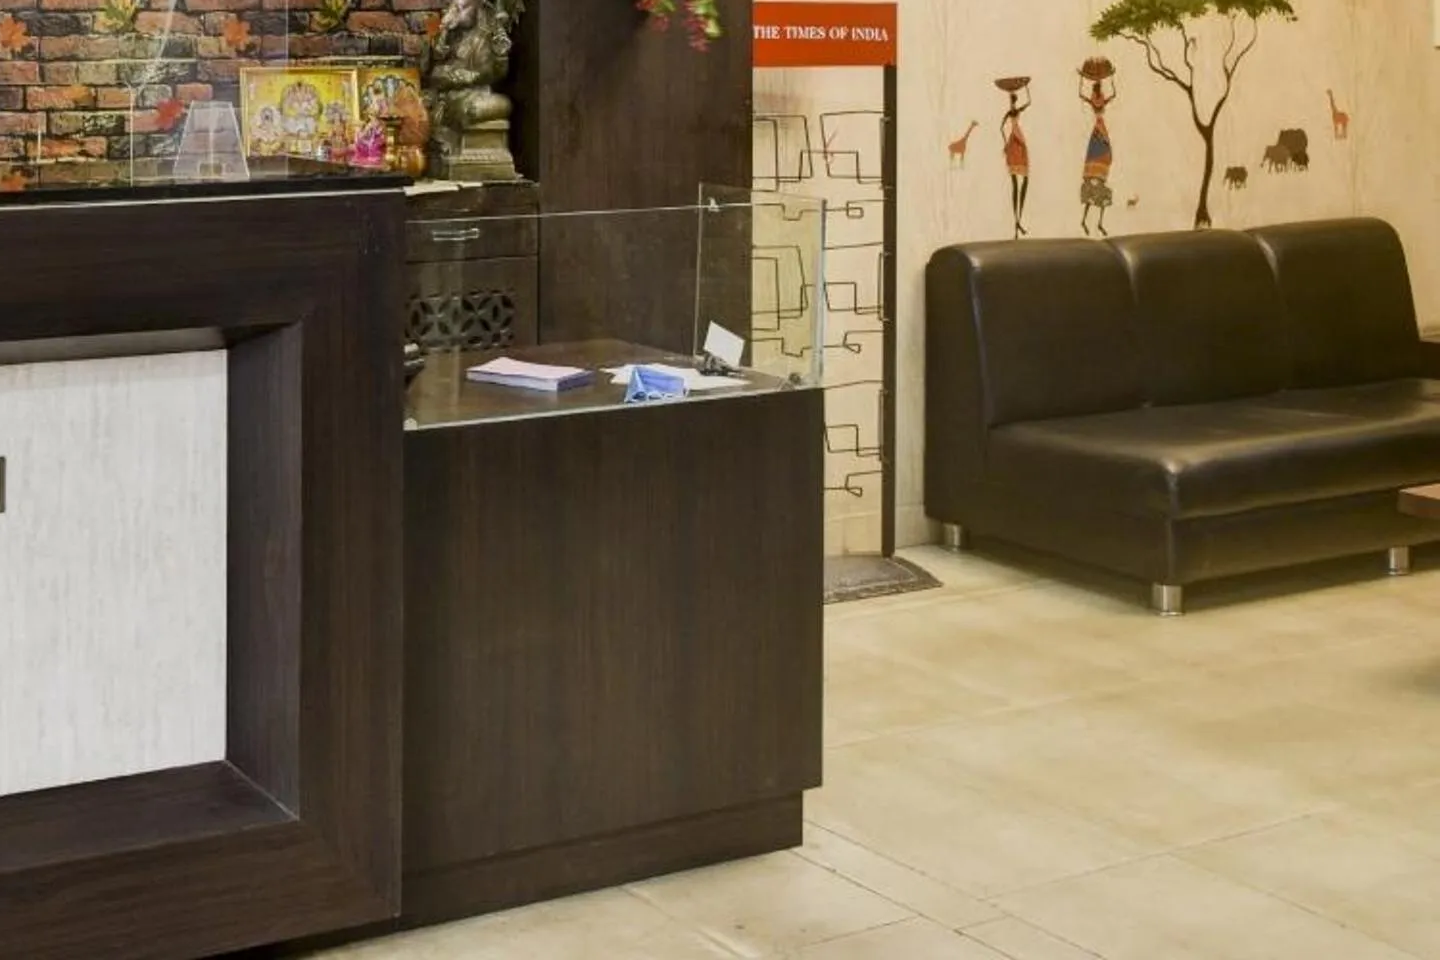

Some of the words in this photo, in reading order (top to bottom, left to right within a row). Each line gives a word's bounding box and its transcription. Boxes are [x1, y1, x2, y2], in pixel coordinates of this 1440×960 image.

[753, 24, 780, 40] THE
[784, 24, 826, 40] TIMES
[828, 26, 849, 40] OF
[851, 26, 889, 42] INDIA
